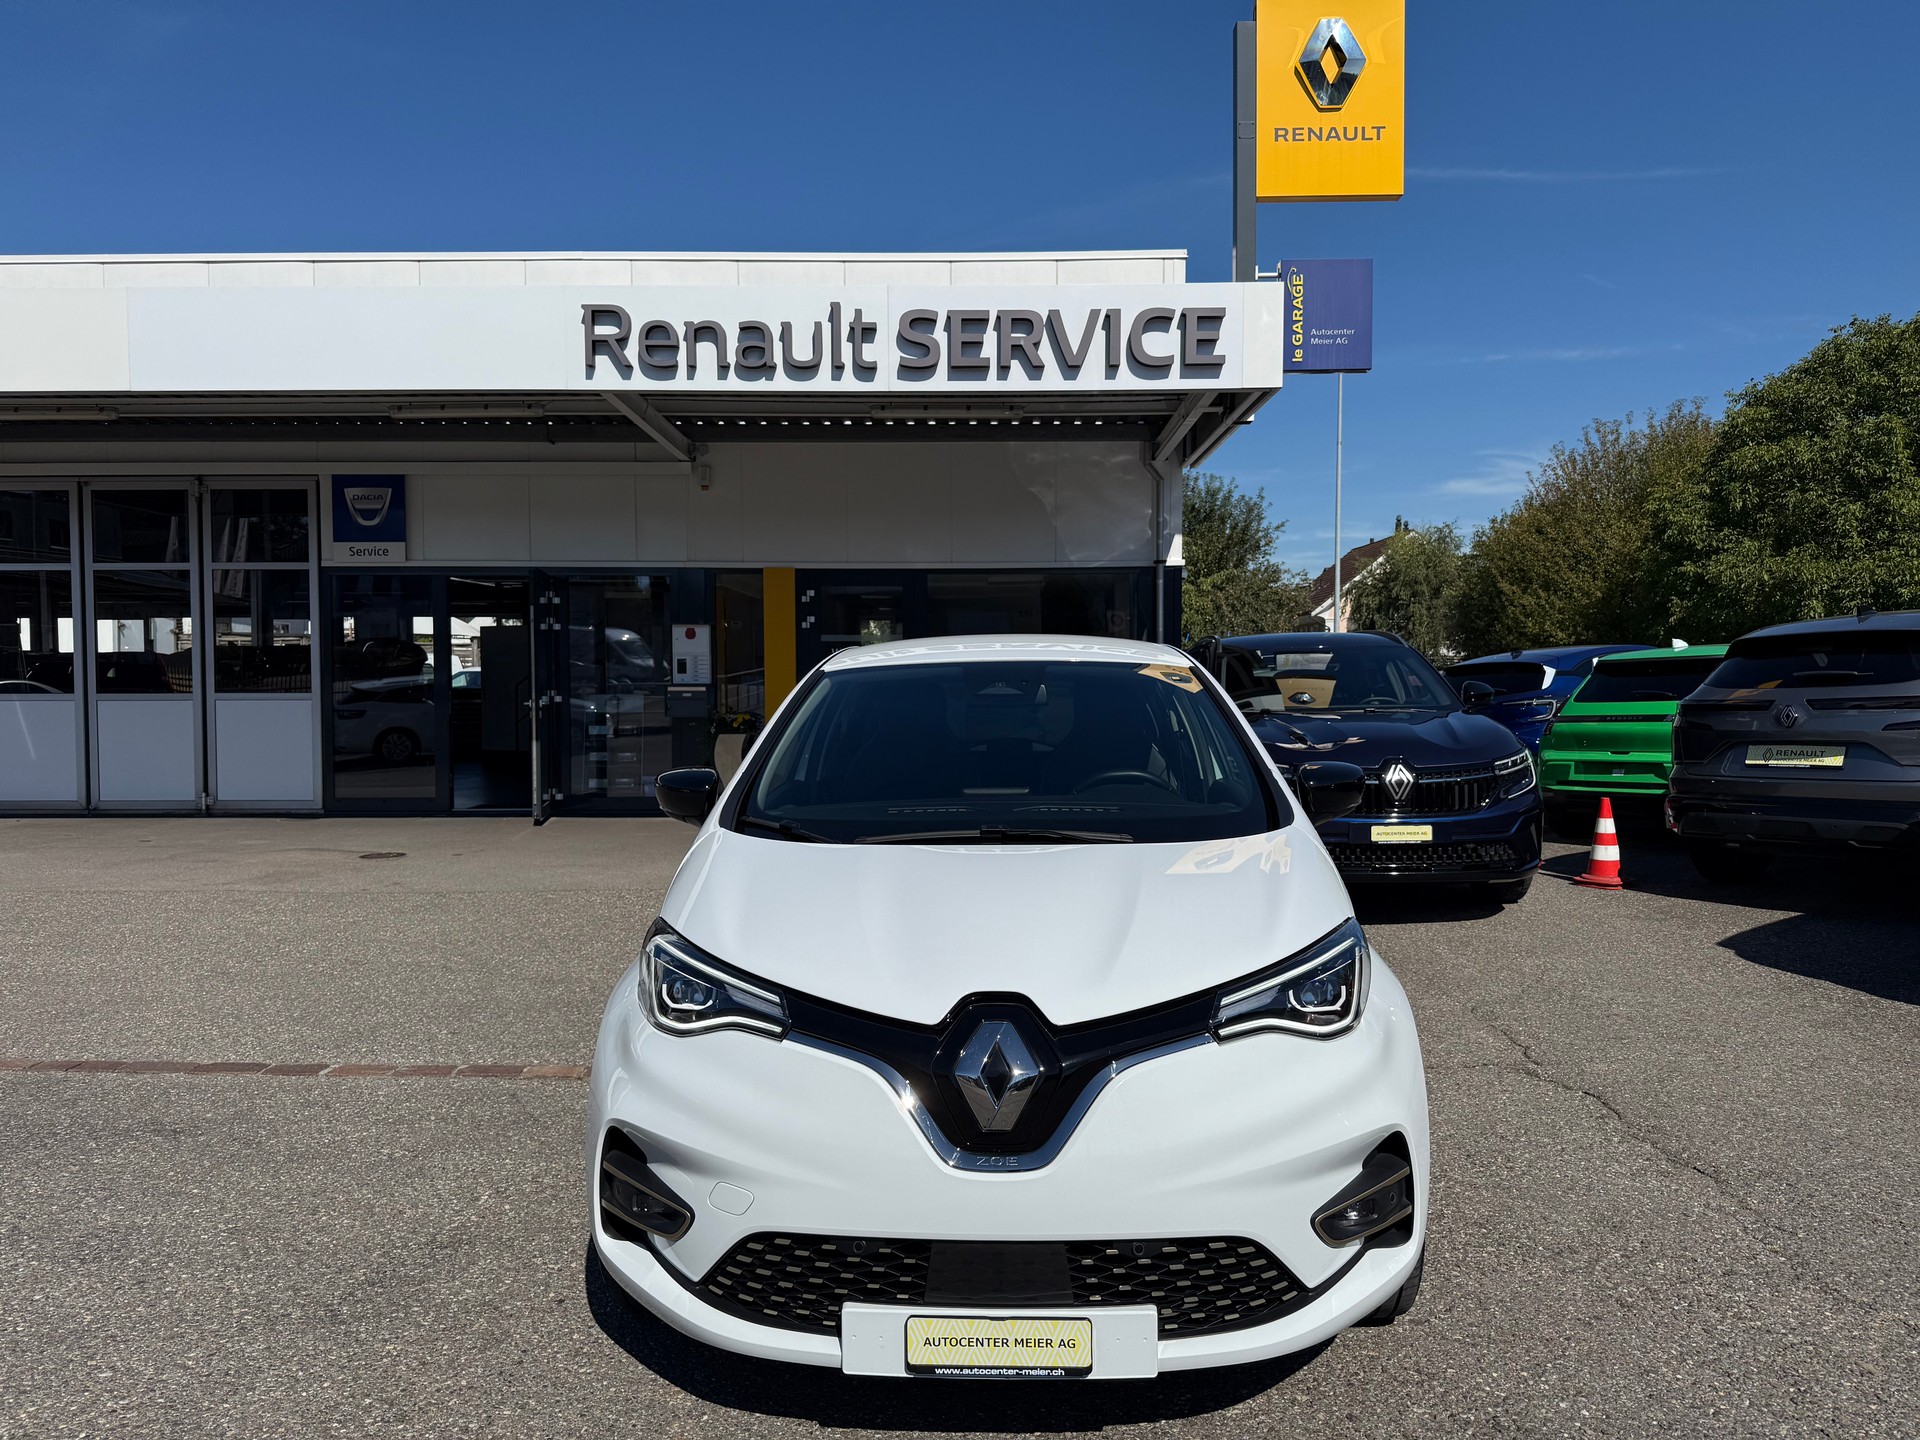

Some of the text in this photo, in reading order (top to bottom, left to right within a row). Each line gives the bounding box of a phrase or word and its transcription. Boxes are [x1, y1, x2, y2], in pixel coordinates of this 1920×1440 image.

[1273, 126, 1386, 142] RENAULT
[1291, 273, 1304, 362] le GARAGE
[582, 301, 1226, 372] Renault SERVICE
[1310, 328, 1355, 336] Autocenter
[1310, 337, 1348, 345] Meier AG
[349, 546, 389, 557] Service
[1775, 749, 1826, 757] RENAULT
[976, 1156, 1018, 1166] ZOE
[923, 1336, 1076, 1349] AUTOCENTER MEIER AG
[934, 1367, 1065, 1376] www.autocenter-meier.ch
